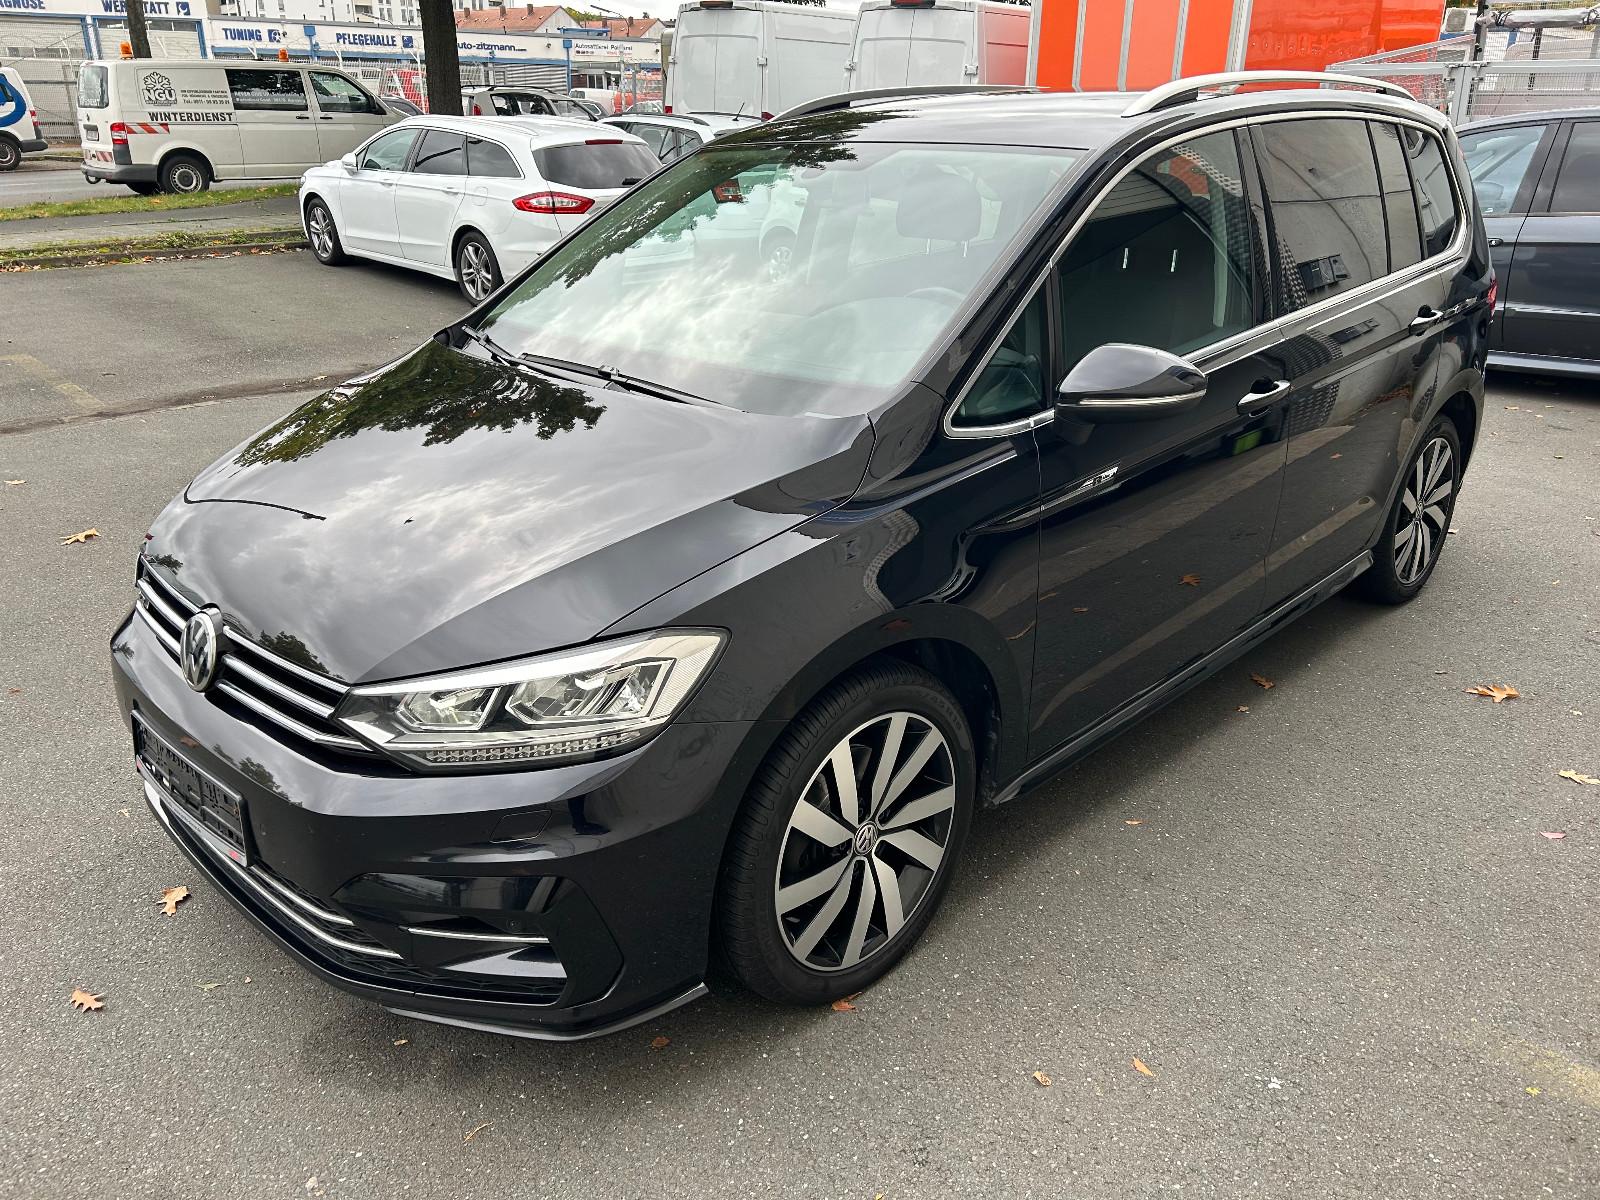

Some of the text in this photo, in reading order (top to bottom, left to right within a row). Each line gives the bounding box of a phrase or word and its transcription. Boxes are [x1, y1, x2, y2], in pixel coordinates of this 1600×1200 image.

[101, 0, 169, 15] WERTATT
[222, 28, 262, 42] TUNING
[336, 32, 397, 47] PFLEGEHALLE
[456, 42, 528, 52] uto-zitzmann.com
[143, 88, 177, 101] NGU
[147, 112, 233, 122] WINTERDIENST
